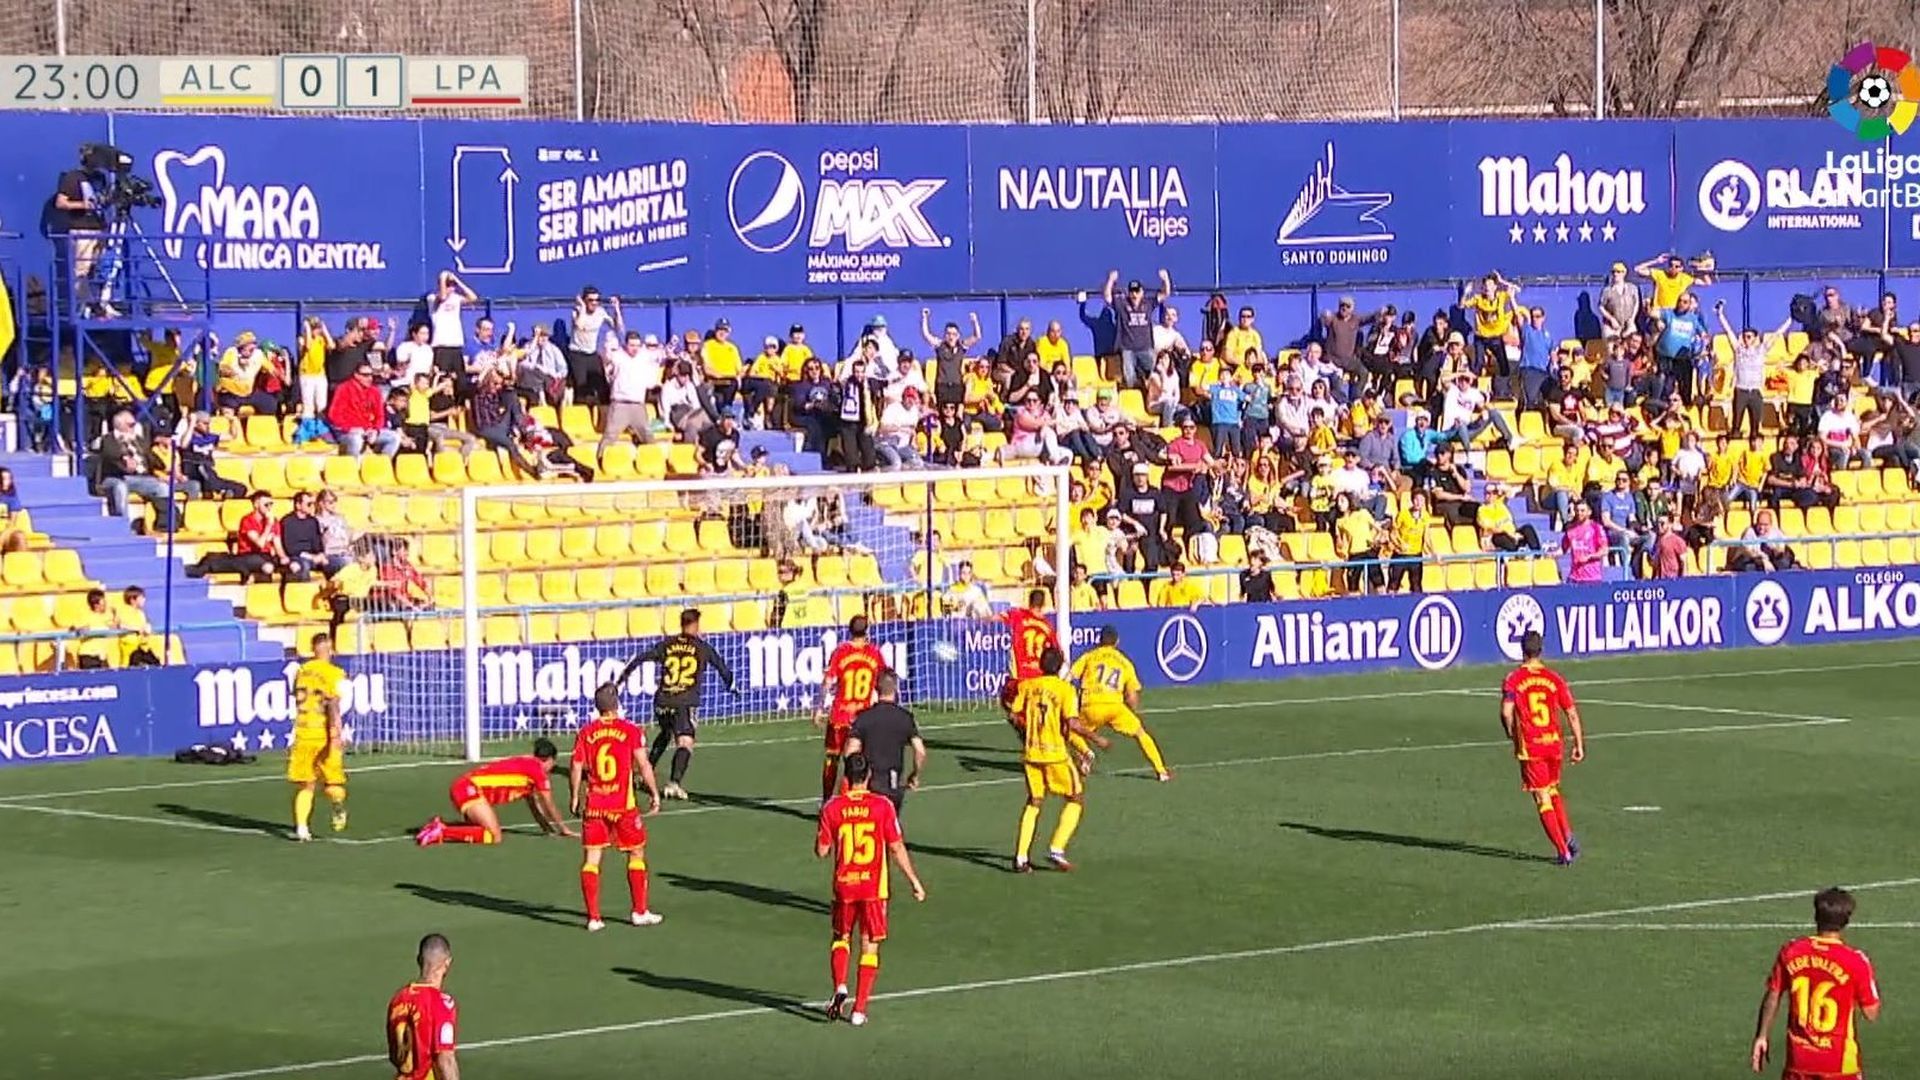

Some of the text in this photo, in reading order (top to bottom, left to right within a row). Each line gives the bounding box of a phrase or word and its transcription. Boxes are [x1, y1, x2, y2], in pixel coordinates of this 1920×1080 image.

[820, 148, 879, 175] pepsi
[538, 160, 687, 212] SER AMARILLO
[1000, 167, 1188, 209] NAUTALIA
[1478, 153, 1646, 216] Mahou
[200, 185, 320, 239] MARA
[538, 191, 688, 243] SER INMORTAL
[808, 179, 948, 251] MAX
[1125, 209, 1189, 245] Viajes
[1767, 214, 1862, 229] INTERNATIONAL
[296, 243, 387, 269] DENTAL
[538, 246, 565, 262] UNA
[567, 239, 600, 257] LATA
[602, 231, 644, 251] NUNCA
[808, 251, 901, 269] MÁXIMO SABOR
[1282, 248, 1389, 265] SANTO DOMINGO
[808, 267, 887, 283] zero azúcar
[1613, 588, 1666, 602] COLEGIO
[1852, 570, 1904, 584] COLEGIO
[1556, 597, 1723, 653] VILLALKOR
[1803, 581, 1920, 634] ALKO
[1251, 611, 1400, 667] Allianz
[664, 655, 698, 686] 32
[746, 629, 909, 687] Mau
[1096, 663, 1121, 690] 14
[843, 668, 873, 702] 18
[1528, 691, 1551, 728] 5
[596, 742, 617, 782] 6
[838, 822, 877, 866] 15
[1791, 975, 1838, 1033] 16
